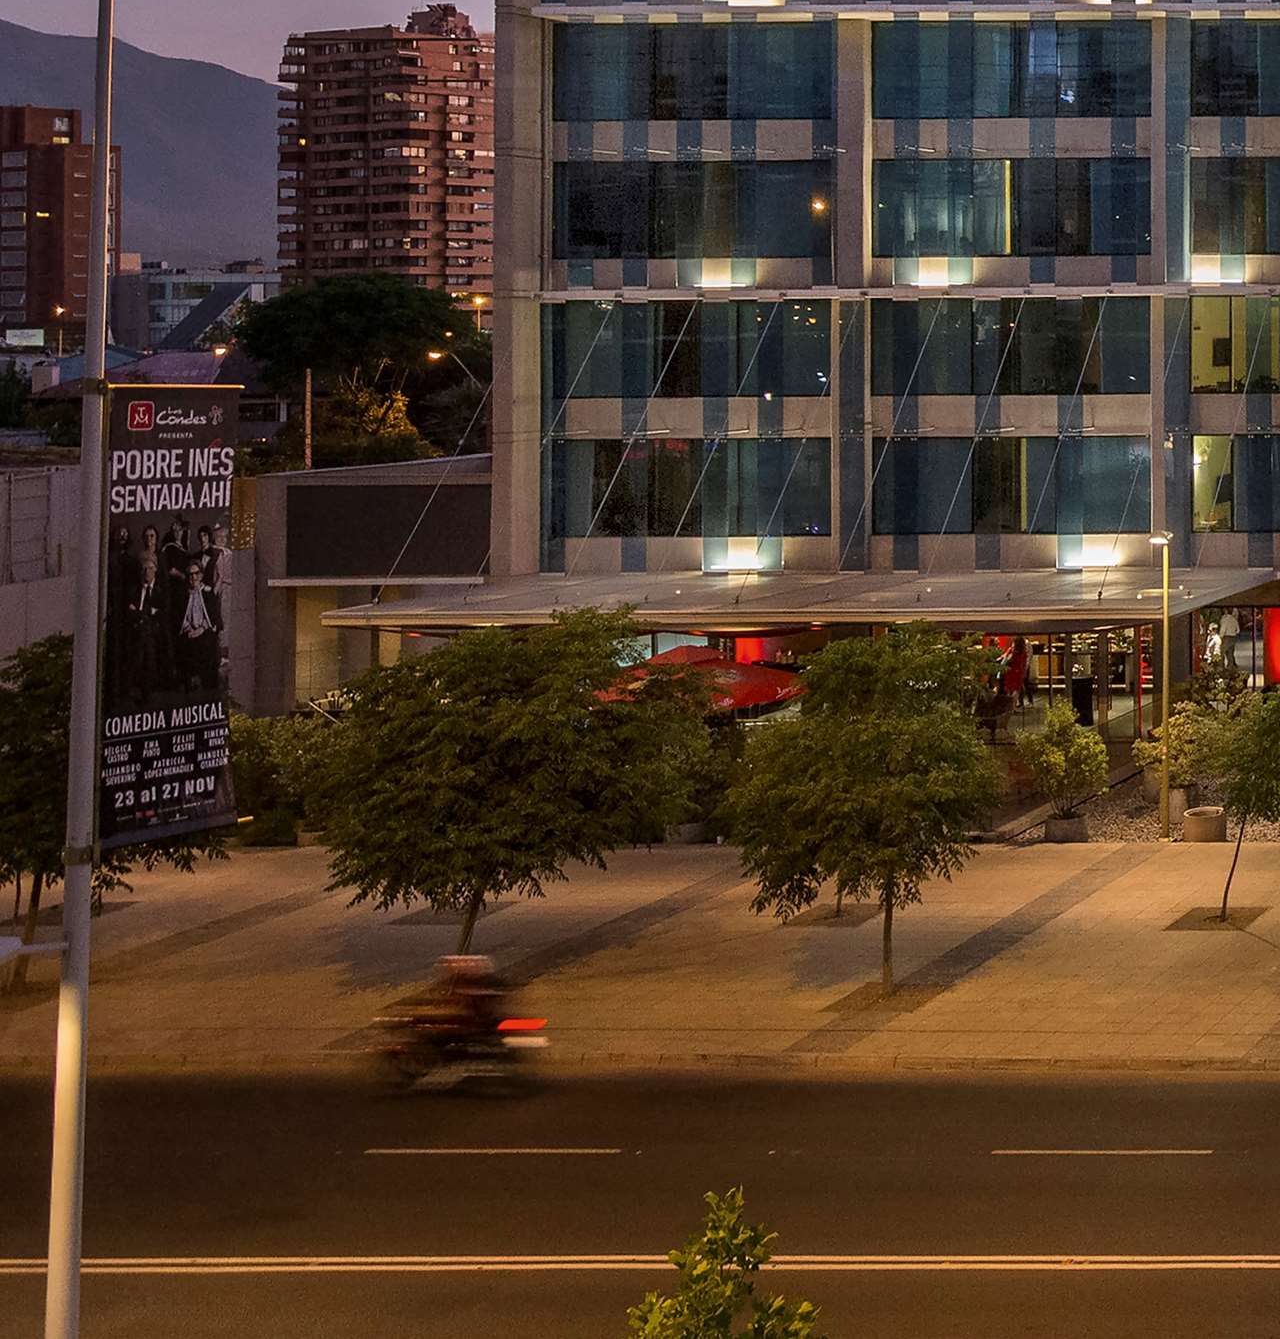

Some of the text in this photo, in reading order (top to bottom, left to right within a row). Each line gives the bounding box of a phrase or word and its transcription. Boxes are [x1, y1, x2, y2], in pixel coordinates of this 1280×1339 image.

[156, 409, 207, 425] Condes
[112, 448, 183, 481] POBRE
[110, 474, 233, 514] SENTADA AHÍ
[105, 702, 225, 737] COMEDIA MUSICAL
[114, 775, 215, 808] 23 al 27 NOV
